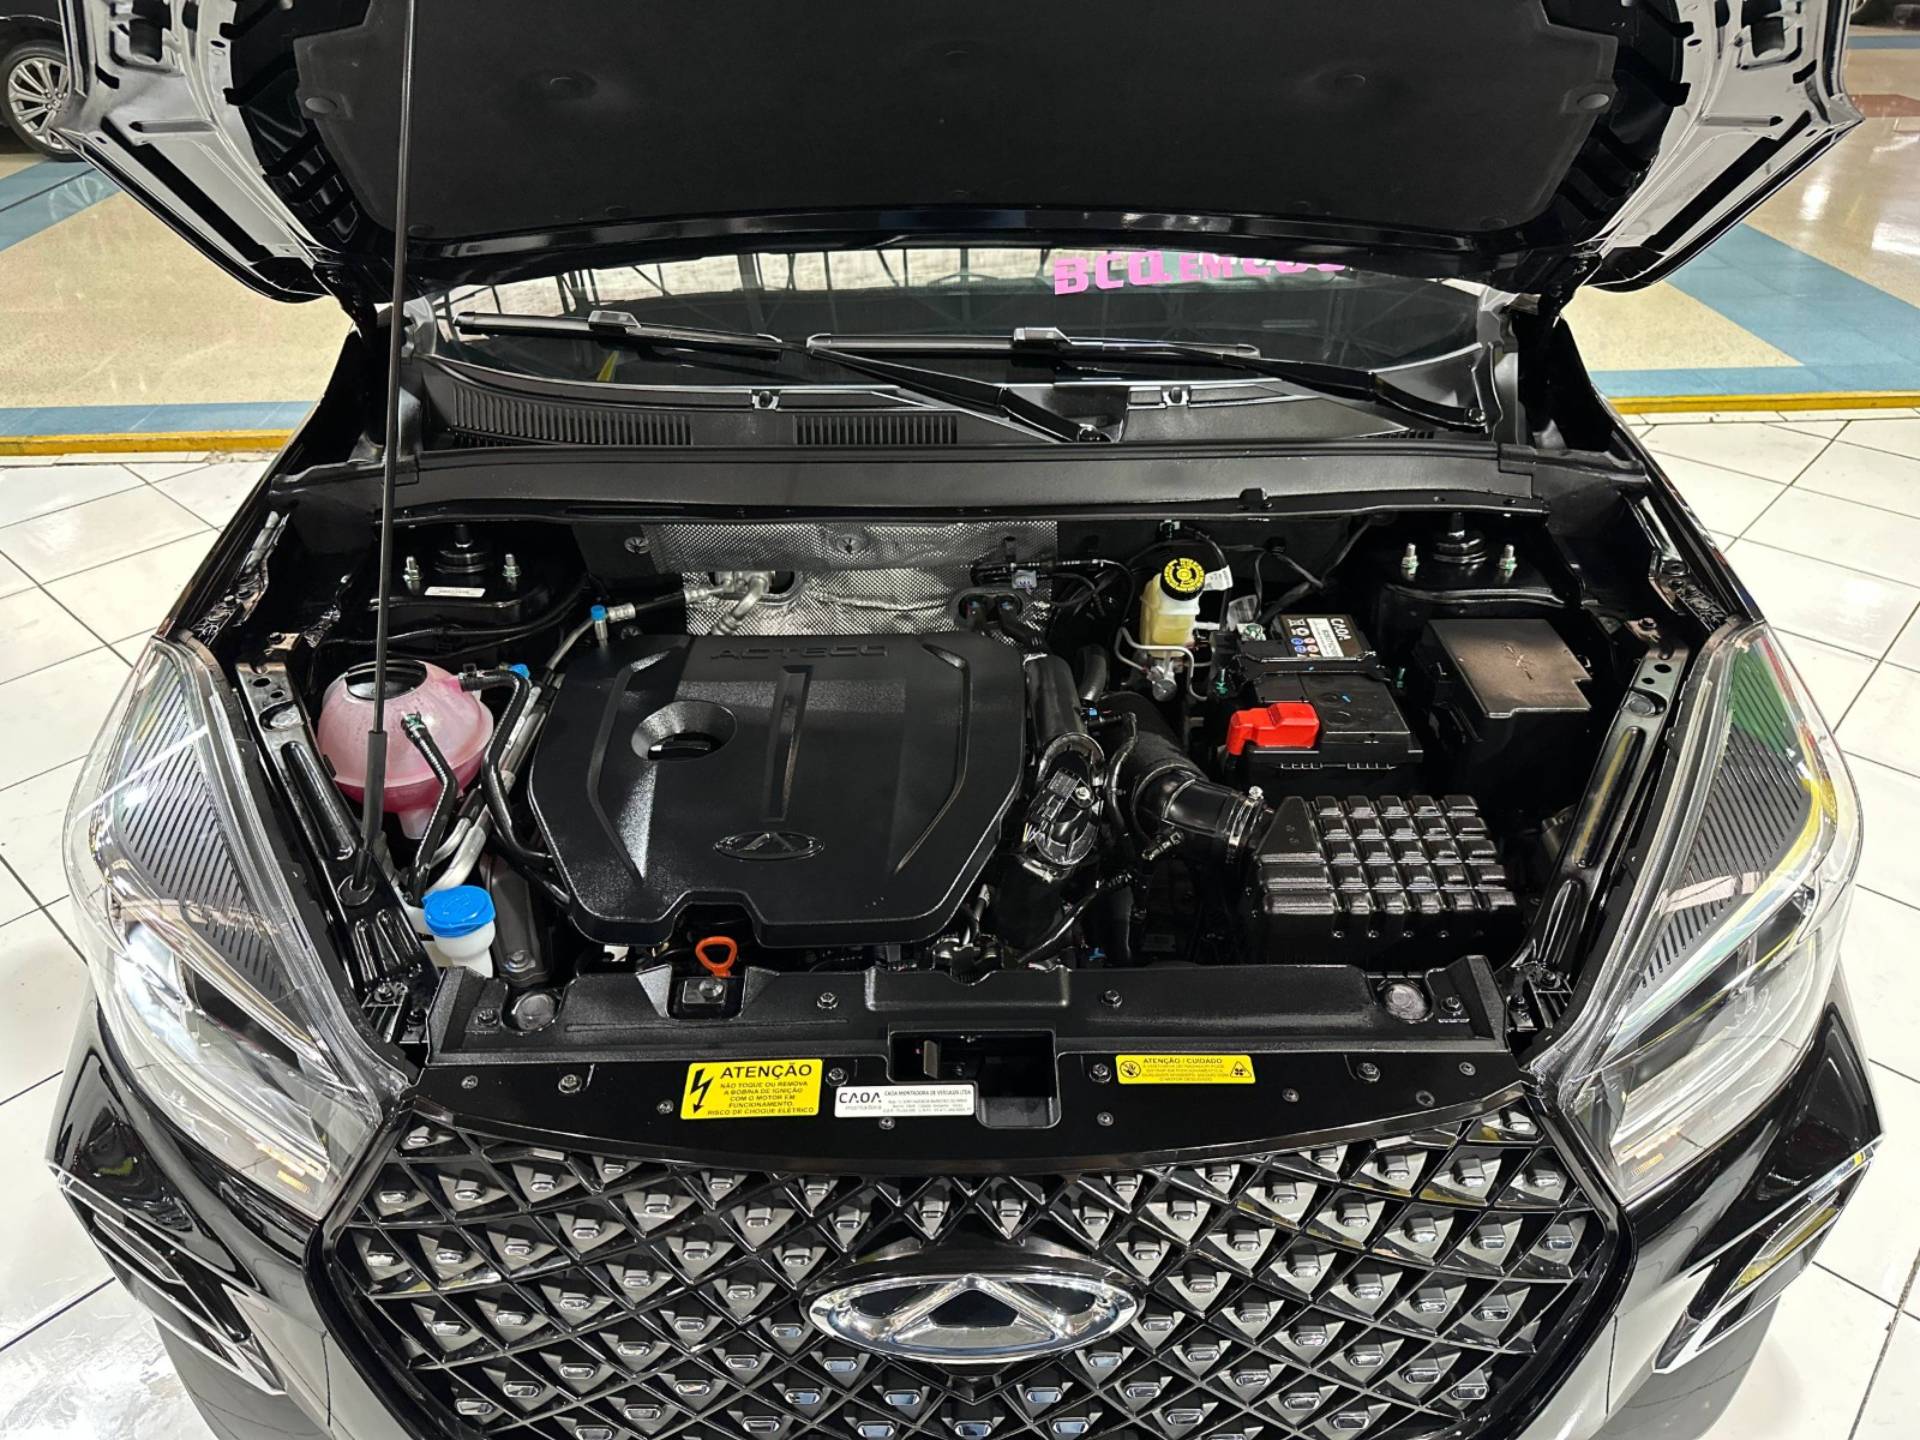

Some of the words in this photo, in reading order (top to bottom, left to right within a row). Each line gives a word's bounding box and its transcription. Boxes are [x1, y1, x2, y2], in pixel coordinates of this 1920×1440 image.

[1143, 1057, 1181, 1065] ATENÇÃO
[720, 1062, 813, 1080] ATENÇÃO
[738, 1081, 763, 1089] TOQUE
[777, 1080, 808, 1088] REMOVA
[730, 1095, 747, 1103] COM
[756, 1094, 782, 1102] MOTOR
[839, 1091, 882, 1104] CAOA
[744, 1107, 776, 1115] CHOQUE
